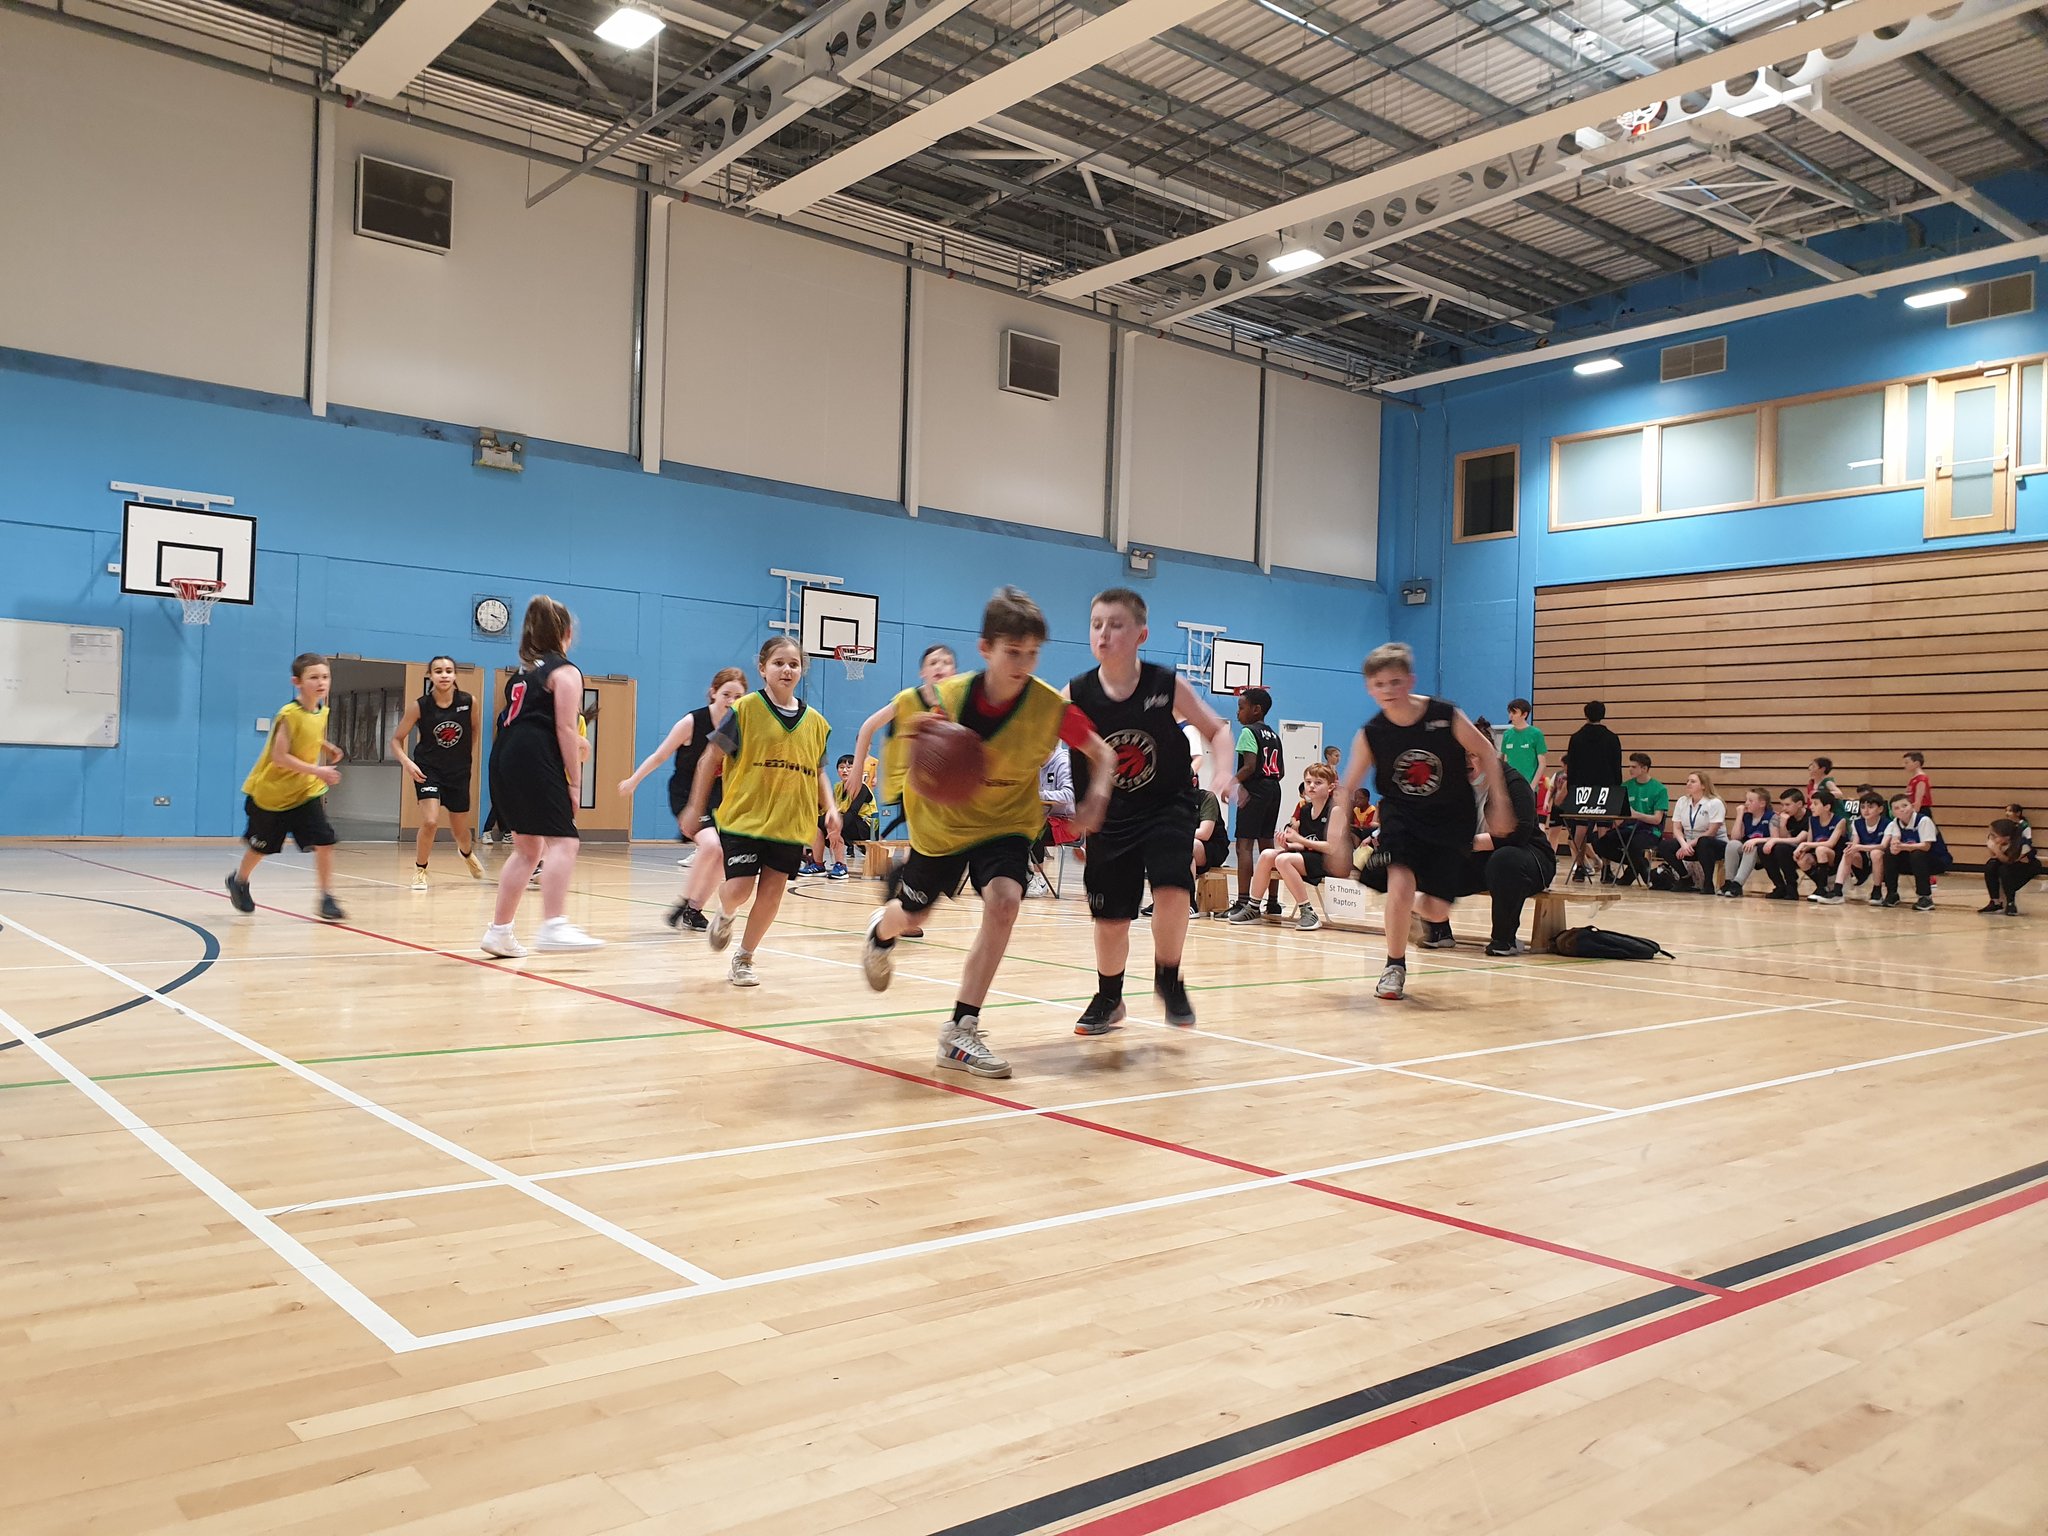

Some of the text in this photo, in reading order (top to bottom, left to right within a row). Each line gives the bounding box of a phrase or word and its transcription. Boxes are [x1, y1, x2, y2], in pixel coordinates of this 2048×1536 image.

[1262, 746, 1280, 777] 14
[1597, 787, 1609, 805] 2
[1329, 884, 1361, 896] St Thomas
[1333, 897, 1357, 907] Raptors
